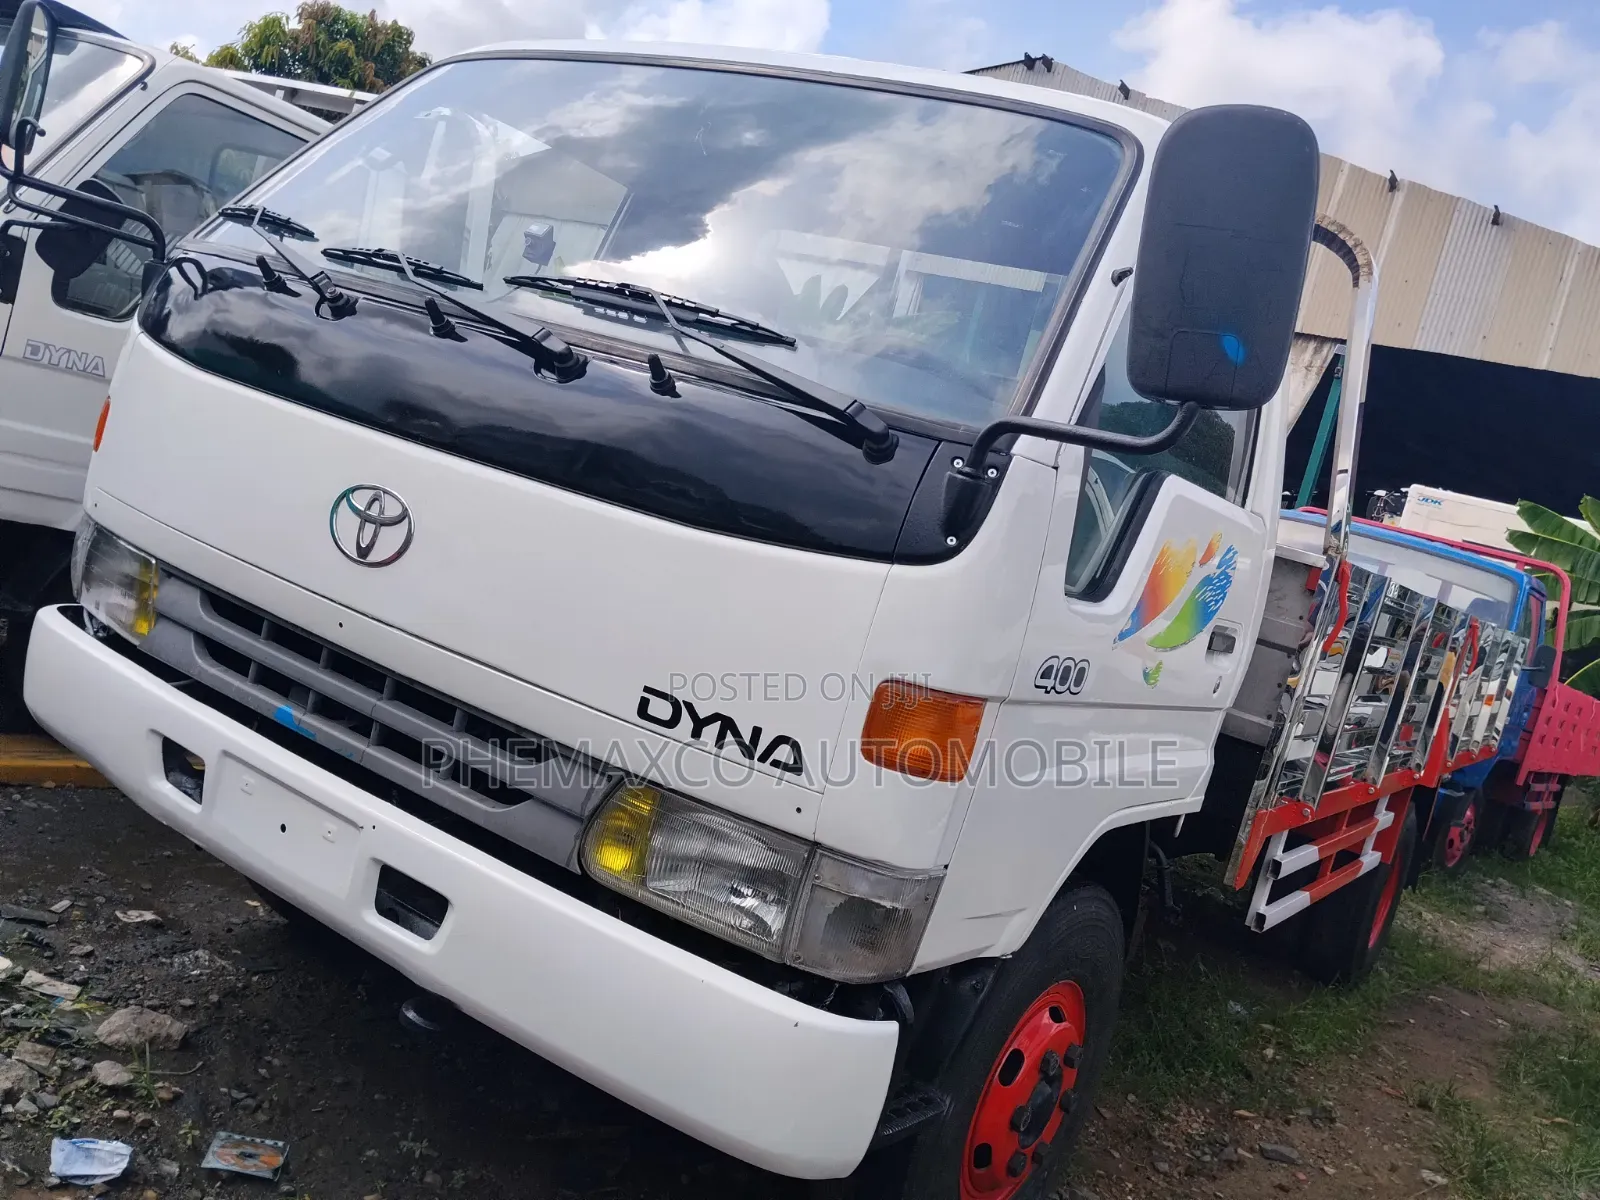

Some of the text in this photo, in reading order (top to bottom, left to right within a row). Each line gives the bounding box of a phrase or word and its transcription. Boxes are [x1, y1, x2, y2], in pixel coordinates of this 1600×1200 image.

[22, 338, 106, 378] DYNA
[1034, 655, 1090, 695] 400
[636, 685, 803, 776] DYNA
